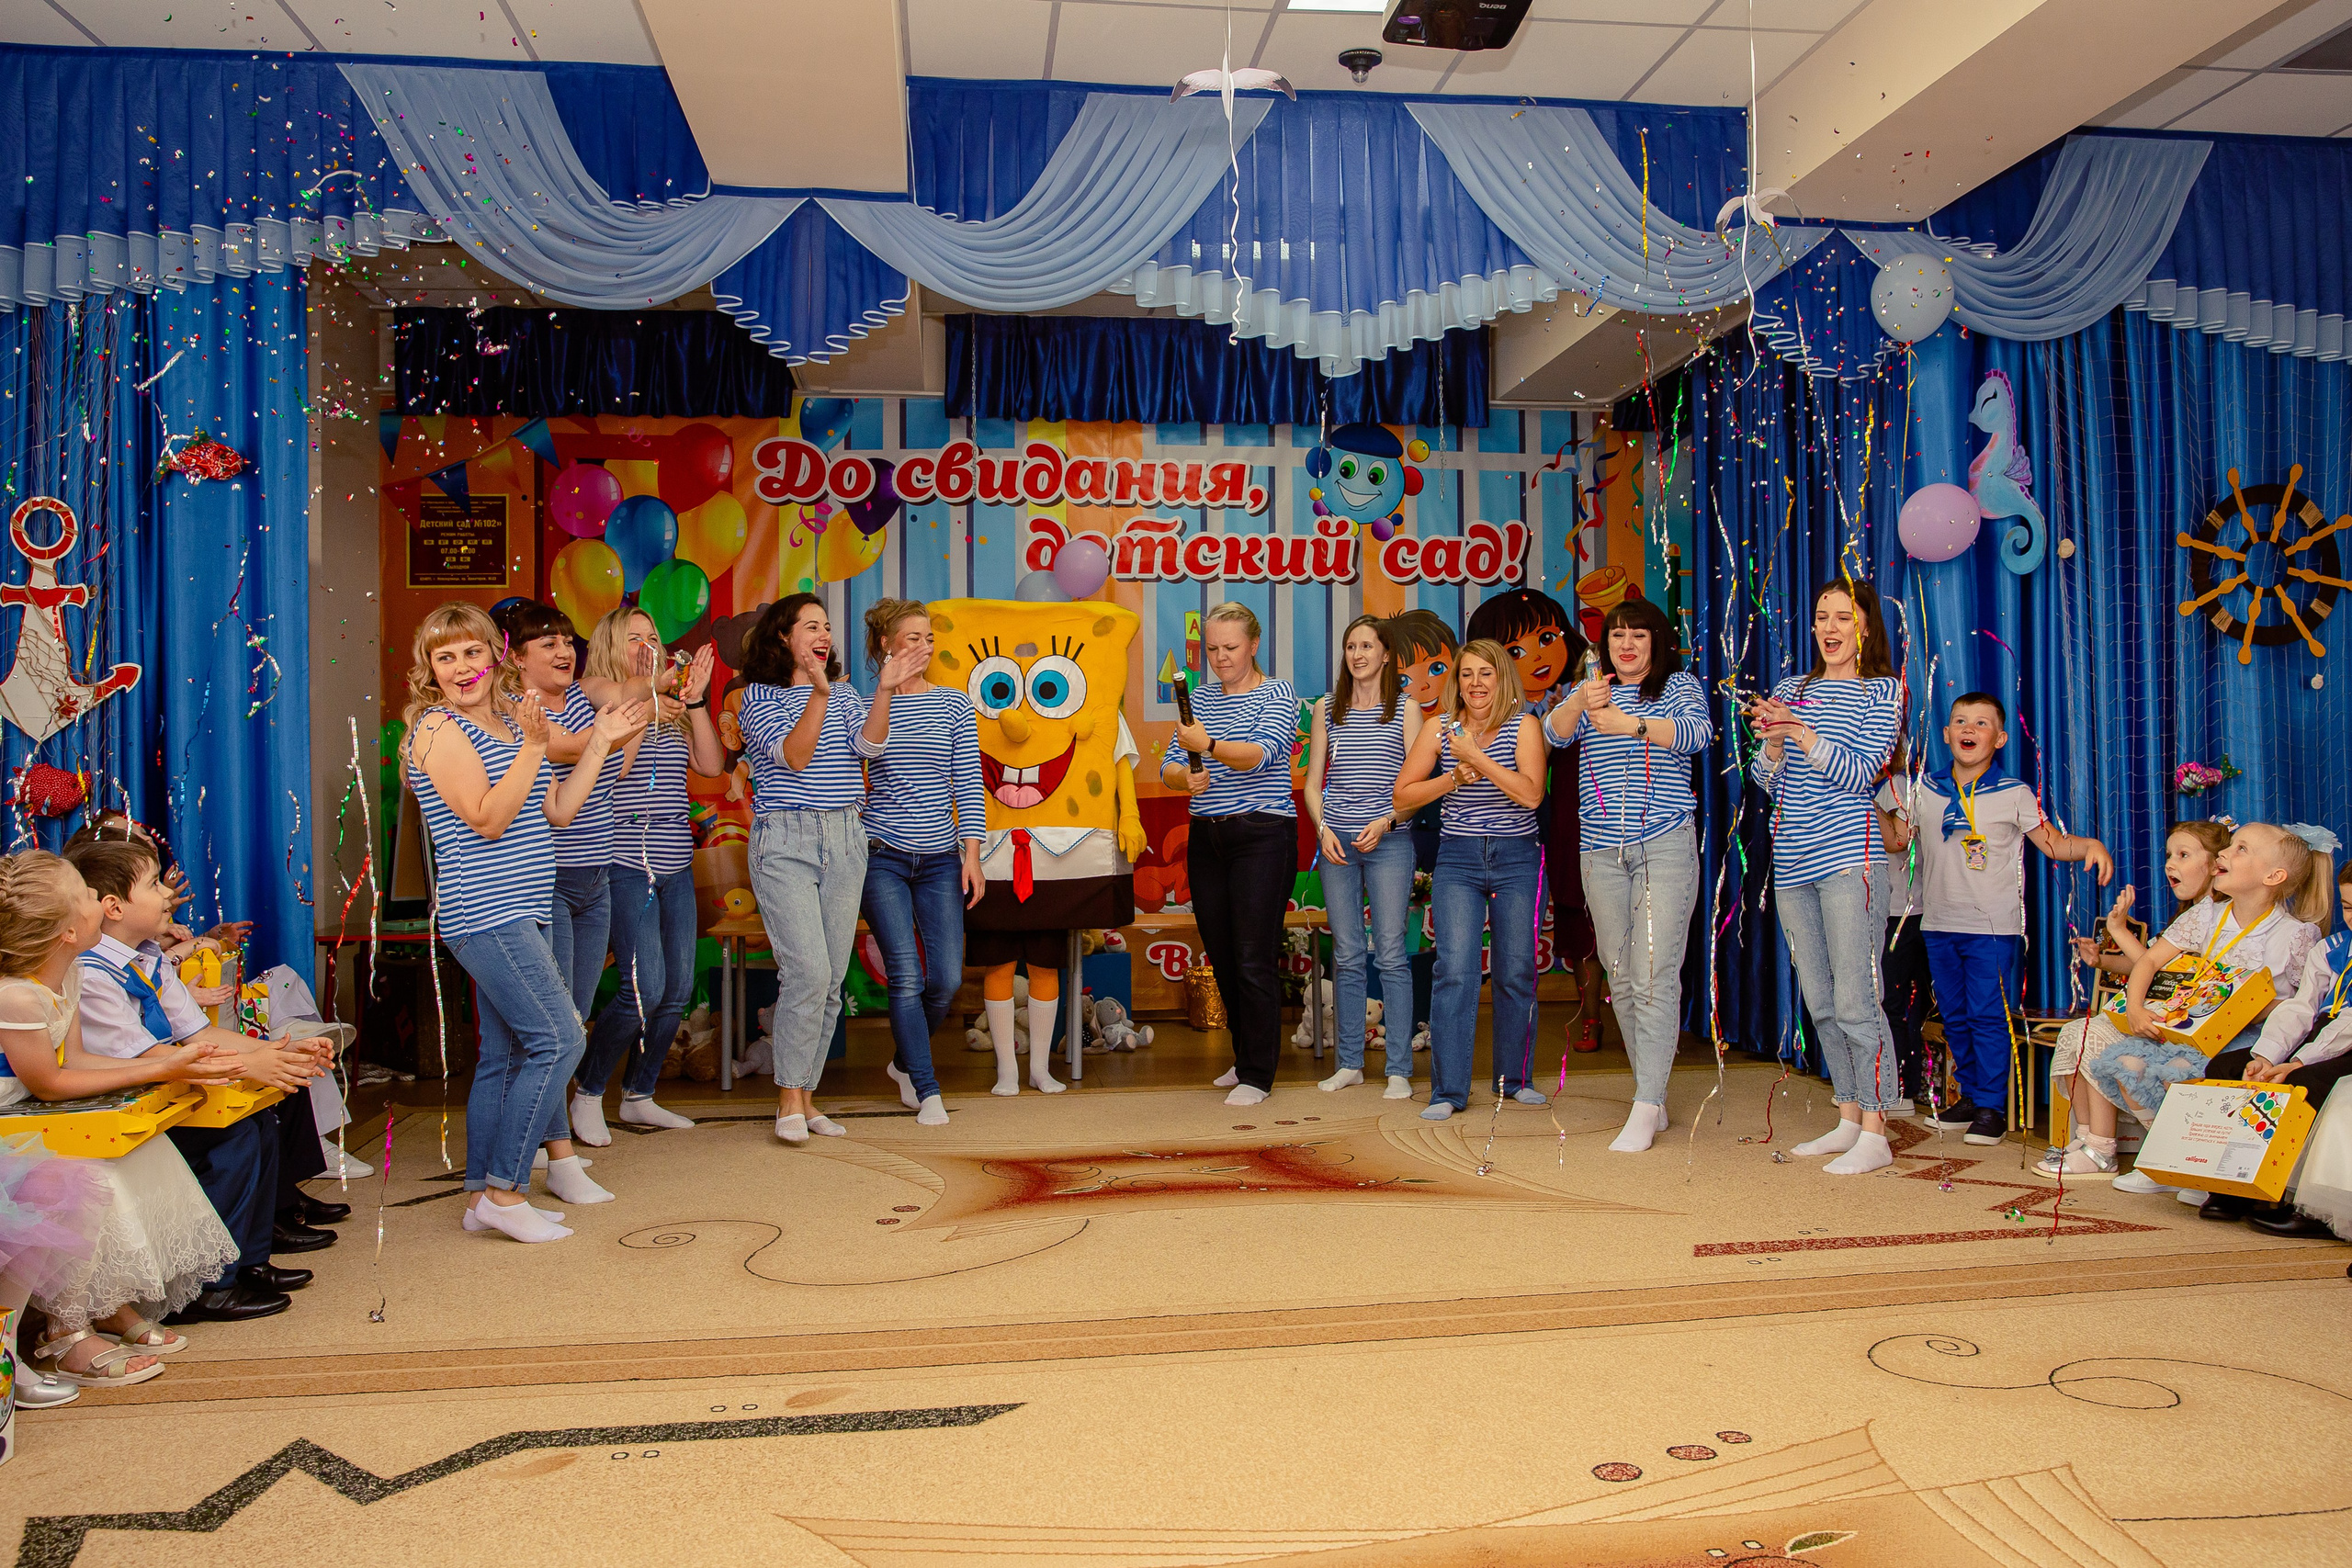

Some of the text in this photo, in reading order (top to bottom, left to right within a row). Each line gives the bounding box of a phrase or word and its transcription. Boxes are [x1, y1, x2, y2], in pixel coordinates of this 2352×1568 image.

[753, 437, 1268, 515] До свидания,
[420, 520, 454, 528] Детский
[1023, 514, 1527, 582] дтский сад!
